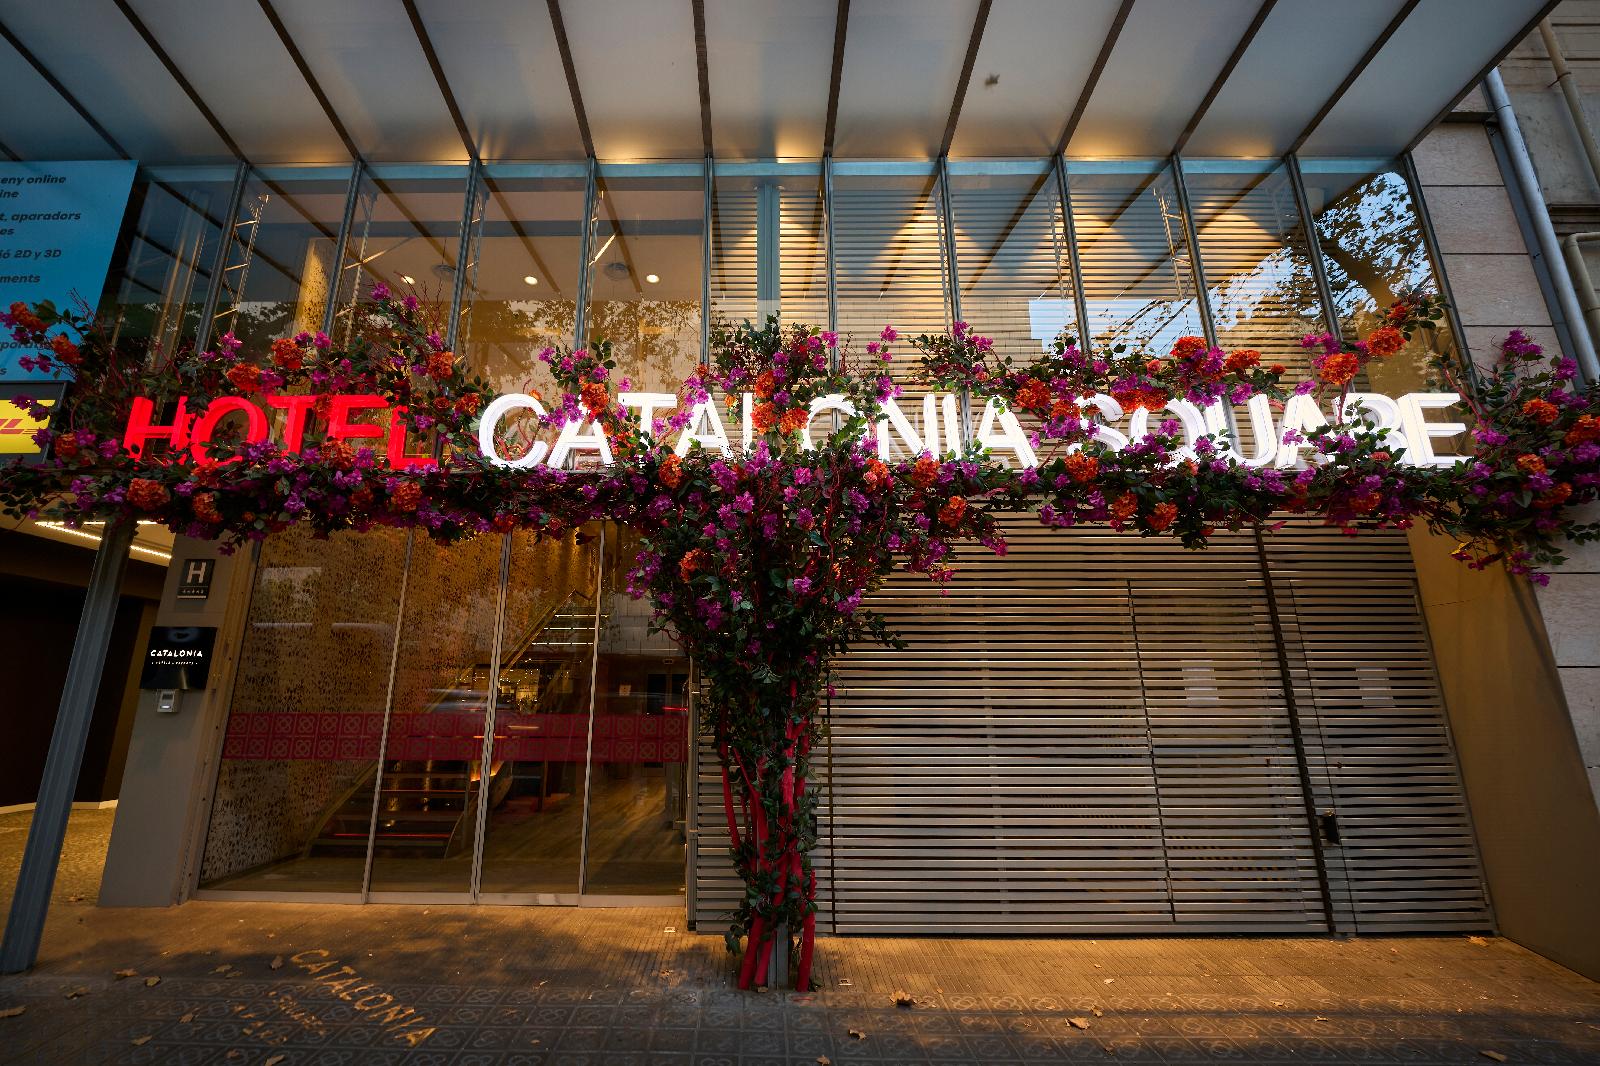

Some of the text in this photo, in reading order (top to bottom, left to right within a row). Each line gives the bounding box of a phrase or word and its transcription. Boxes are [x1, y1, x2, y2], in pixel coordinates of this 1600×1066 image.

[26, 174, 66, 184] online
[11, 211, 81, 223] aparadors
[14, 249, 32, 258] 2D
[34, 251, 42, 260] y
[44, 249, 62, 258] 3D
[122, 394, 438, 471] HOTEL
[1066, 391, 1470, 470] SQUARE
[150, 649, 203, 658] CATALONIA
